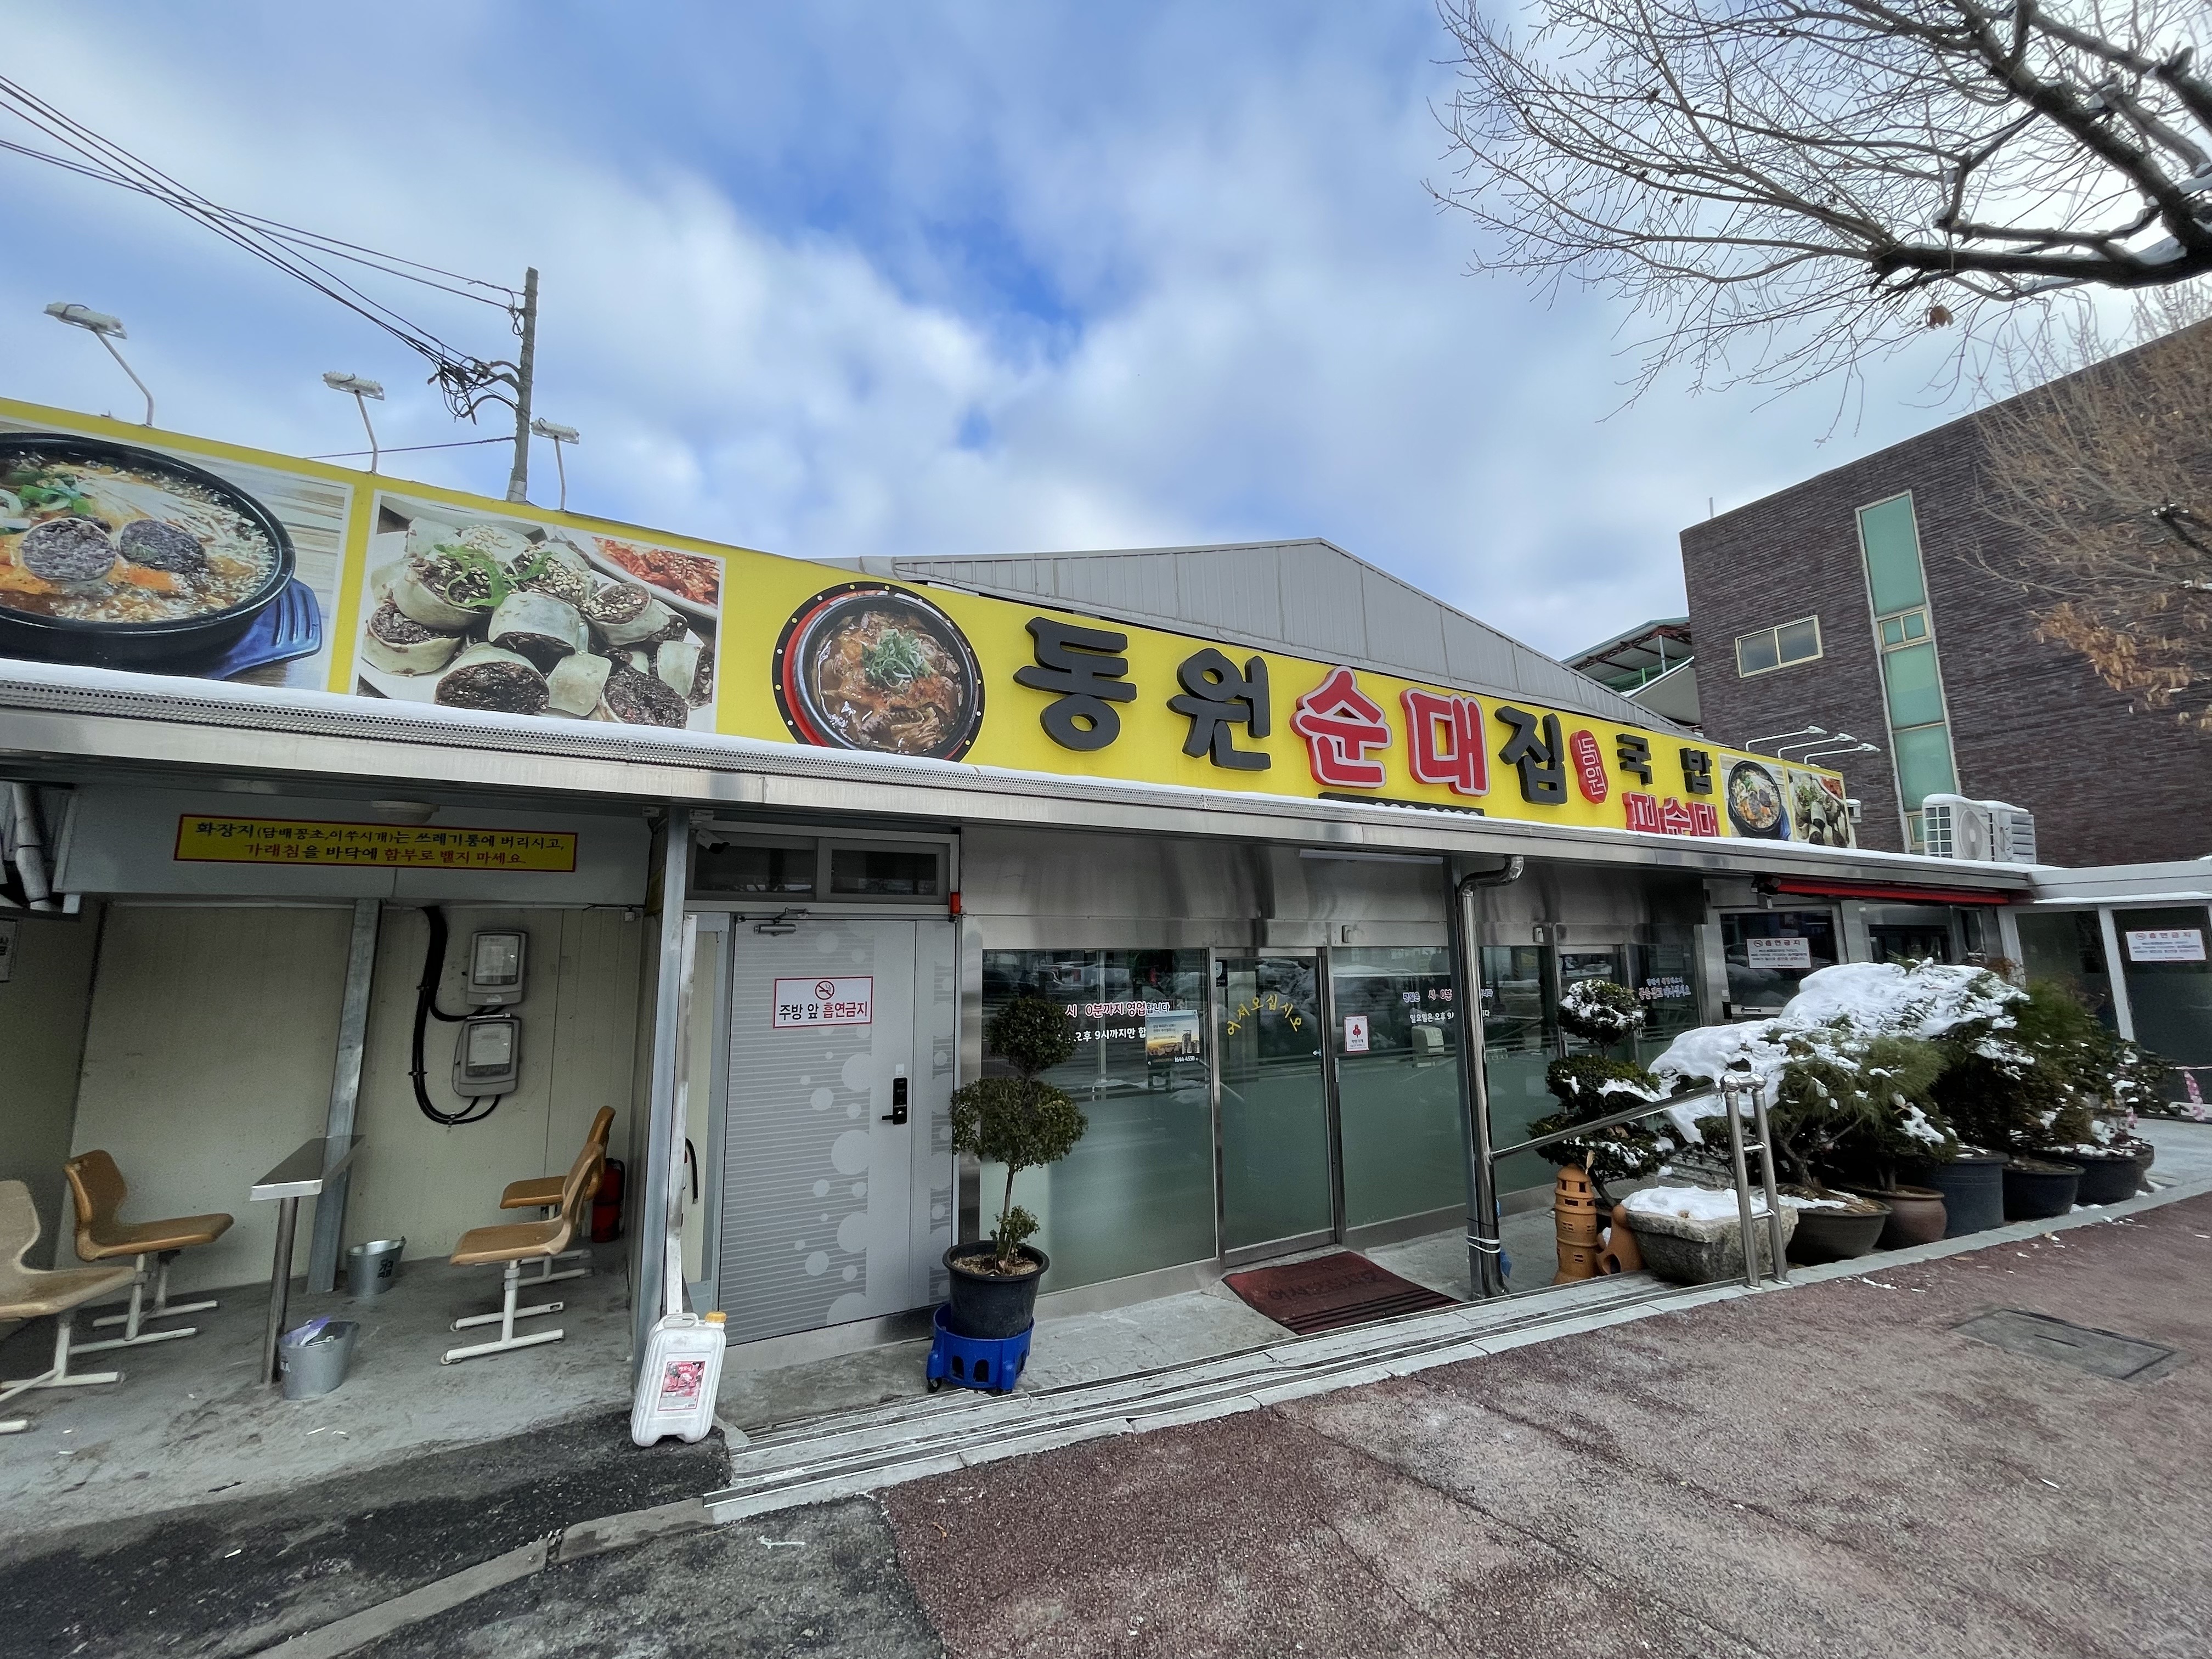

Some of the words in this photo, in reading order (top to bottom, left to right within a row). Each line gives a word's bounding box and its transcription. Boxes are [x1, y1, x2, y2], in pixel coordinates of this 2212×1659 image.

[414, 832, 495, 848] 쓰레기통에
[500, 836, 565, 851] 버리시고,
[245, 843, 320, 859] 가래침을
[325, 846, 376, 861] 바닥에
[384, 848, 435, 862] 함부로
[440, 850, 470, 864] 뱉지
[1403, 991, 1421, 1003] 평일은
[779, 1003, 803, 1020] 주방
[808, 1003, 819, 1019] 앞
[823, 1001, 867, 1019] 흡연금지
[1065, 1004, 1077, 1018] 시
[1085, 1002, 1125, 1018] 0분까지
[1227, 994, 1302, 1036] 어서오십시오
[1410, 1012, 1434, 1024] 일요일은
[1435, 1012, 1446, 1021] 오후
[1094, 1028, 1136, 1040] 9시까지만
